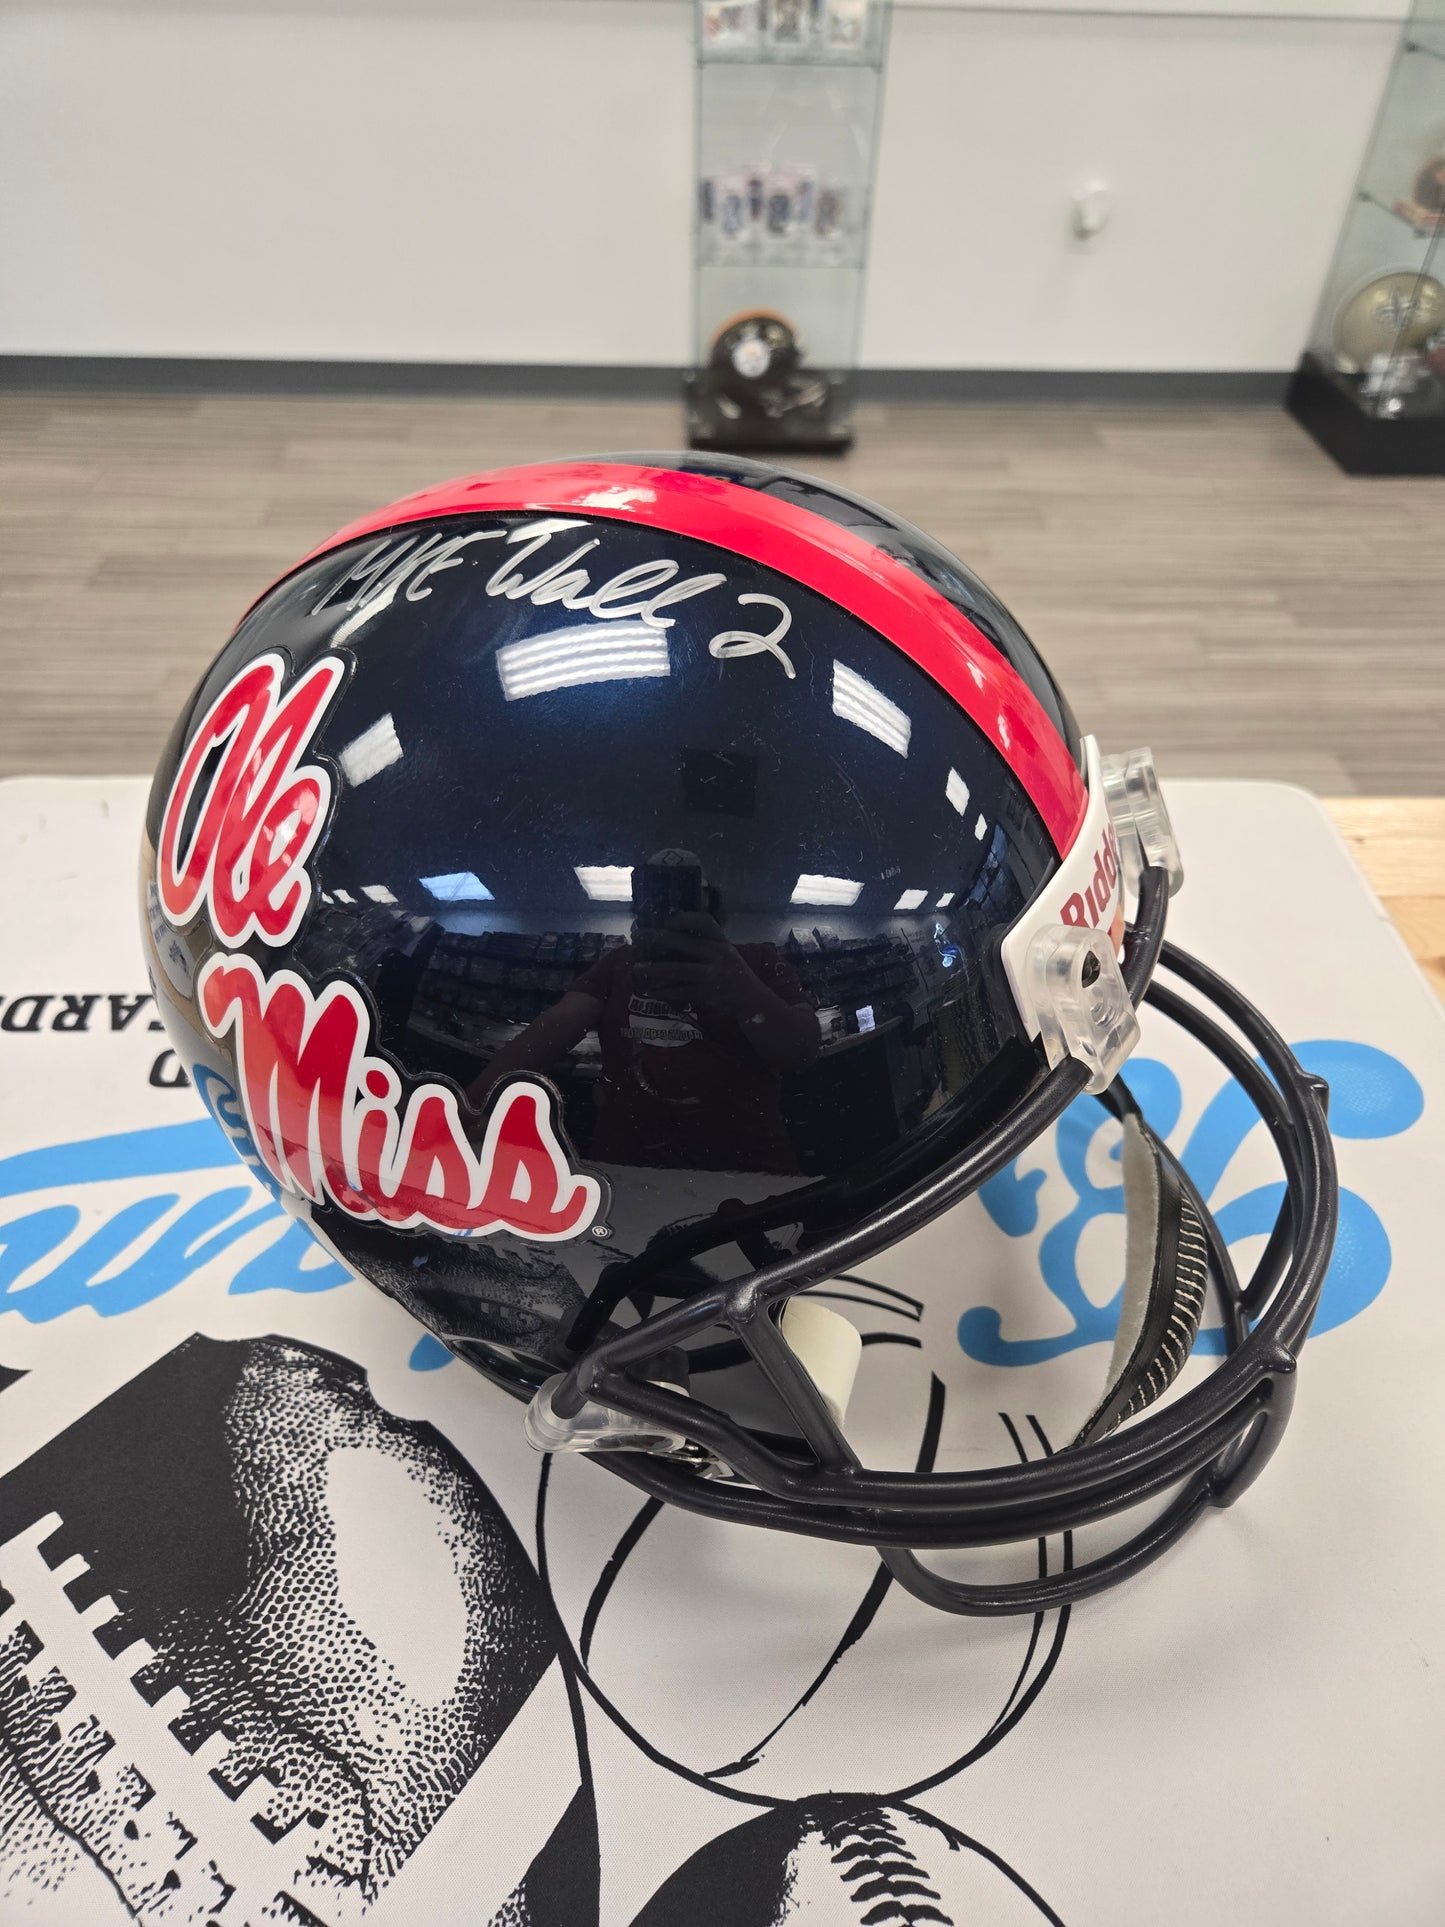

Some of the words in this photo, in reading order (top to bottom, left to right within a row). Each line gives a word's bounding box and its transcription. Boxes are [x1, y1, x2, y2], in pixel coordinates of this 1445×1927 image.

[709, 593, 796, 680] 2
[157, 653, 345, 948] Ole
[0, 994, 165, 1032] ARD
[198, 953, 601, 1242] Miss
